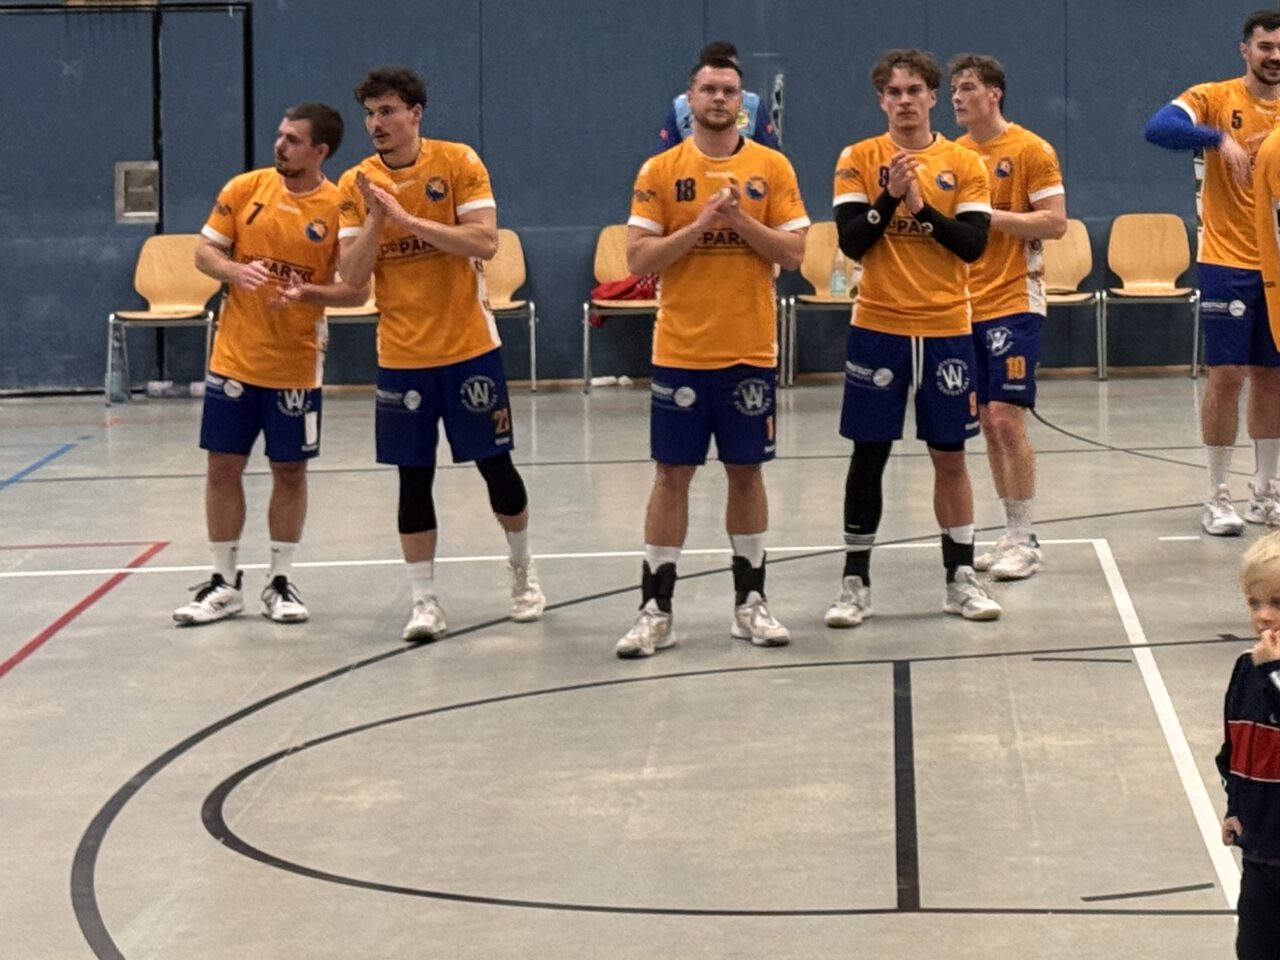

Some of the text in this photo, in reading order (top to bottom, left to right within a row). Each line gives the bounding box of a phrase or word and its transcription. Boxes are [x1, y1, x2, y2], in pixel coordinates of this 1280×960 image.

[1232, 109, 1243, 129] 5
[675, 178, 696, 202] 18
[245, 201, 265, 226] 7
[1005, 355, 1026, 380] 10
